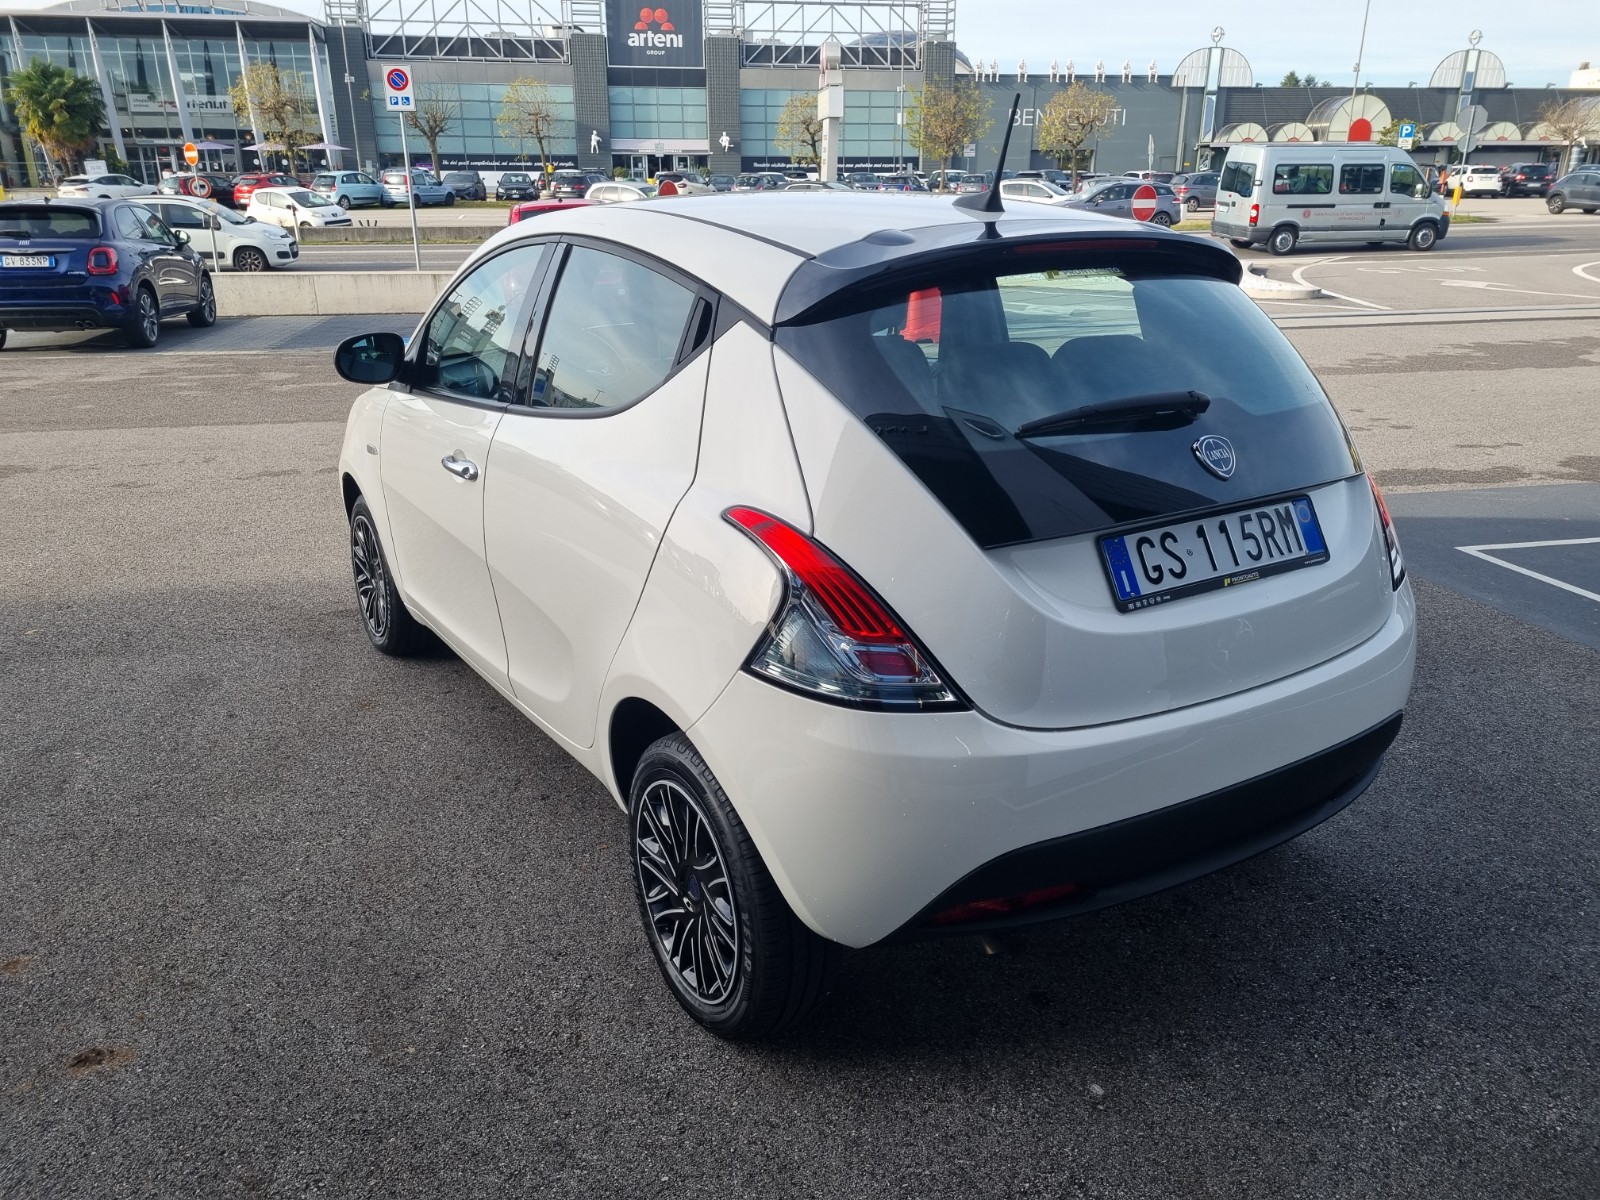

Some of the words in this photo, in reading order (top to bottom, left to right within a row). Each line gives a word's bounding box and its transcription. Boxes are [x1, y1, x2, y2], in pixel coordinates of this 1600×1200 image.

[627, 30, 683, 48] arteni
[186, 100, 228, 109] rteni.it
[1401, 125, 1412, 138] P
[1206, 448, 1230, 461] LANCIA
[1135, 531, 1187, 585] GS
[1196, 505, 1304, 572] 115RM
